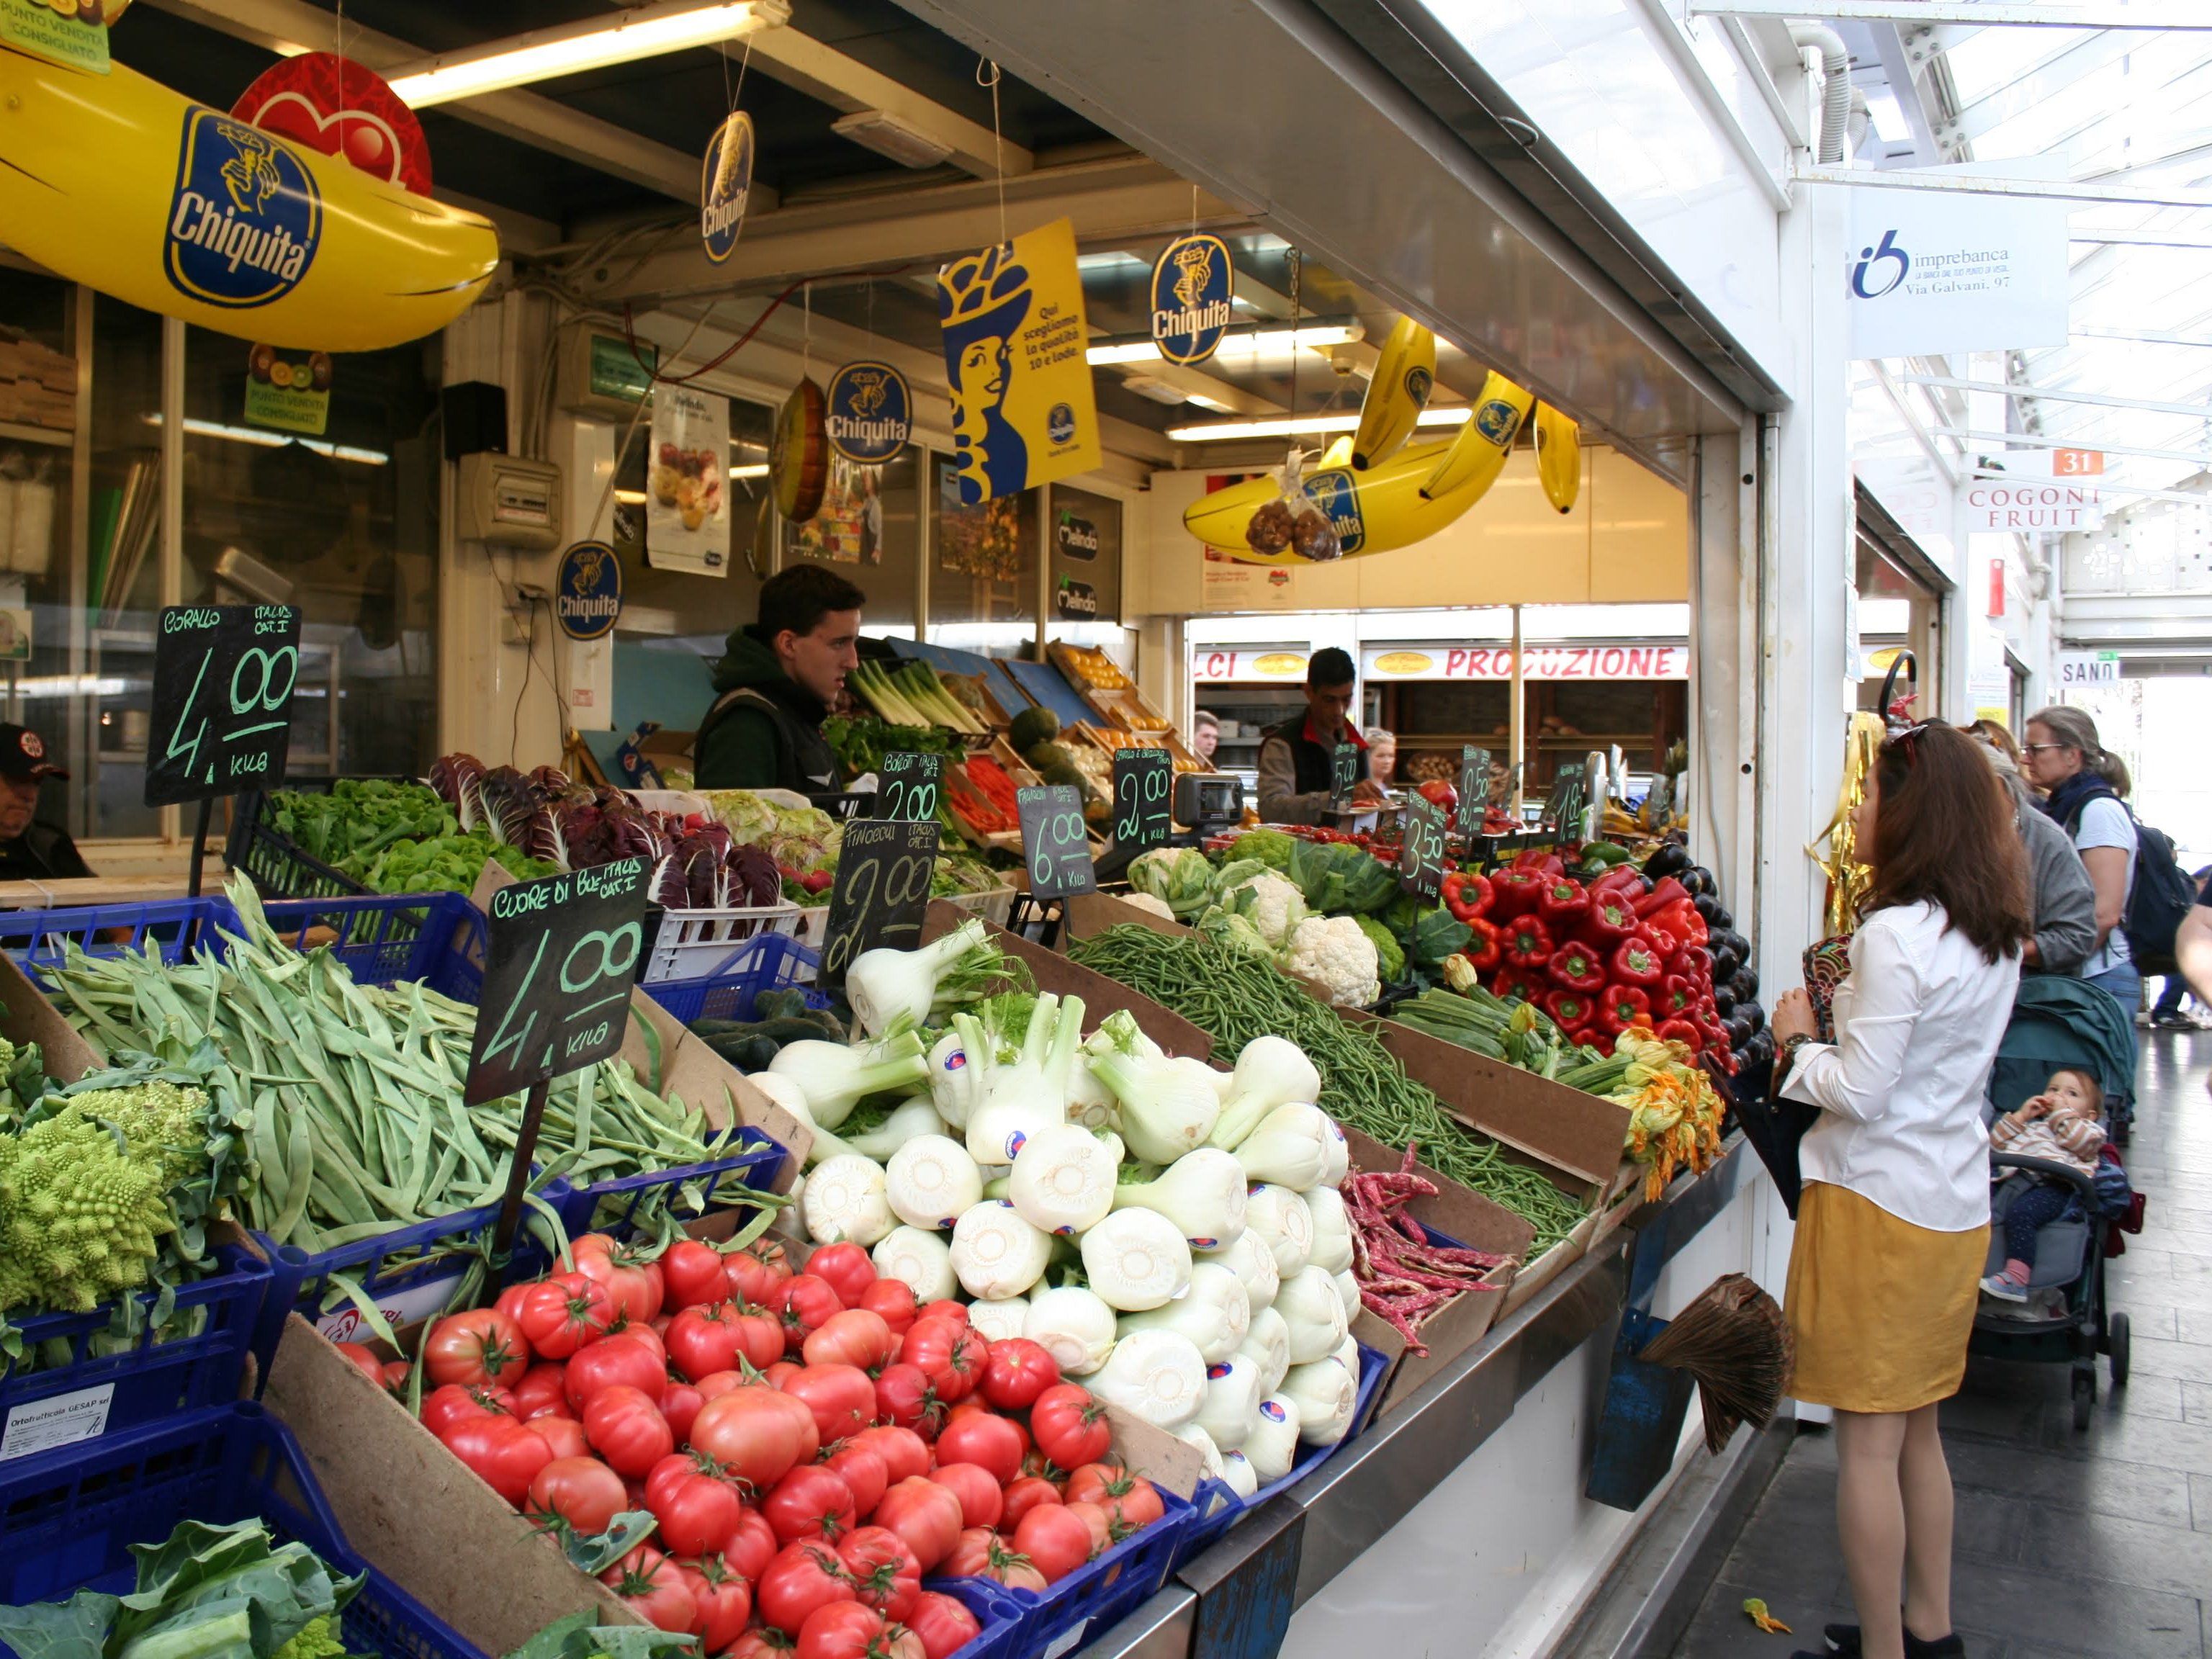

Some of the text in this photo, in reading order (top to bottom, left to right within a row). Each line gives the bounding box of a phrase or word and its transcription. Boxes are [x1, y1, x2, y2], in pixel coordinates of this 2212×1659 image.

[12, 22, 96, 60] CONSIGLIATO
[50, 19, 104, 46] VENDITA
[702, 187, 747, 238] Chiquita
[171, 192, 305, 282] Chiquita
[1915, 249, 2009, 269] imprebanca
[1906, 284, 1927, 295] Via
[1995, 276, 2010, 288] 97
[1040, 302, 1058, 320] Qui
[1152, 300, 1230, 342] Chiquita
[1030, 358, 1042, 370] 10
[1045, 356, 1051, 365] e
[826, 415, 907, 447] Chiquita
[2062, 452, 2091, 473] 31
[1989, 508, 2082, 528] FRUIT
[164, 609, 220, 634] CORALLO
[557, 594, 619, 624] Chiquita
[2063, 663, 2113, 682] SANO
[1068, 870, 1086, 887] KILO
[494, 884, 552, 919] CUORE
[565, 1021, 608, 1058] KILO
[11, 1396, 110, 1427] Ortofrutticola GESAP srl
